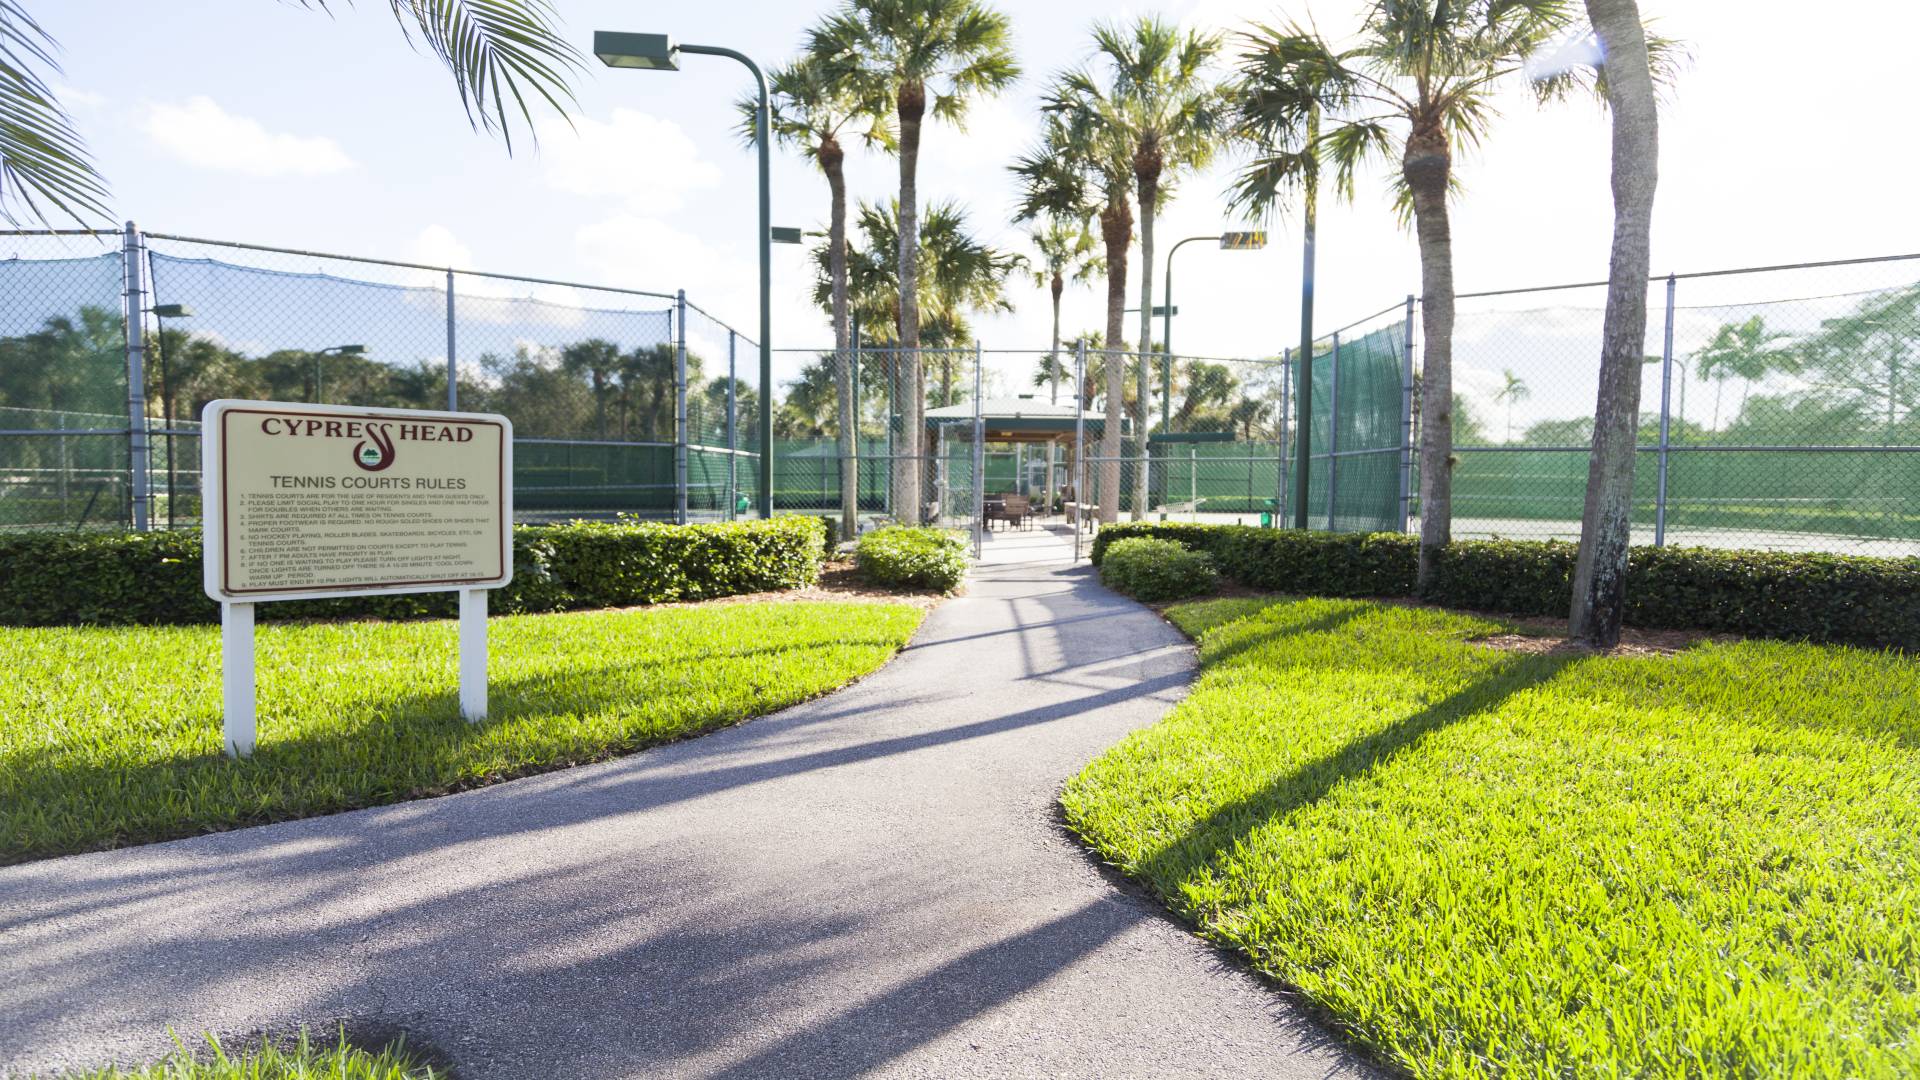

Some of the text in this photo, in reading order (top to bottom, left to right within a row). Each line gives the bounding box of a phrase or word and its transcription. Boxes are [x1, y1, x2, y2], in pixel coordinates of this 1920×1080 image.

[400, 424, 473, 443] HEAD
[270, 475, 466, 490] TENNIS COURTS RULES
